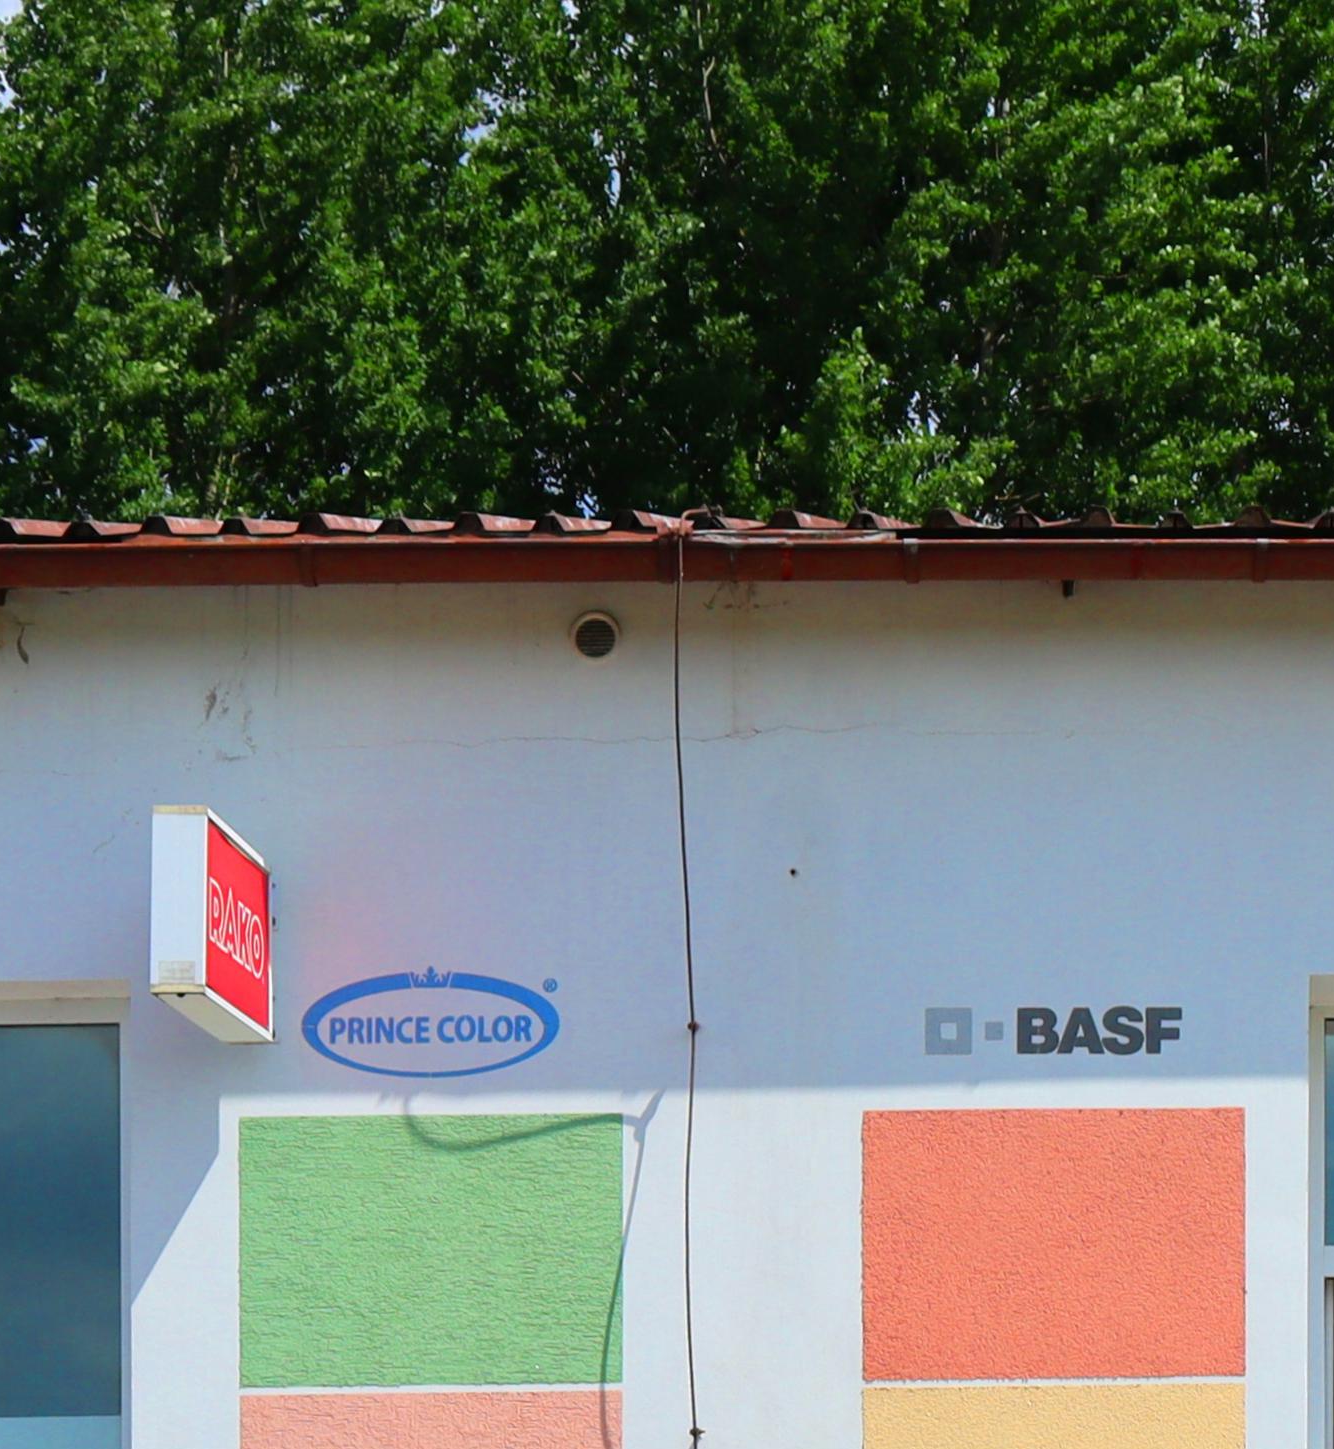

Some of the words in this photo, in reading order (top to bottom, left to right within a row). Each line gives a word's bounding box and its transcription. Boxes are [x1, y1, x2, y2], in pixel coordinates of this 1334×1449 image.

[208, 876, 265, 979] RAKO
[329, 1016, 430, 1045] PRINCE
[436, 1014, 533, 1043] COLOR
[1016, 1005, 1183, 1055] BASF
